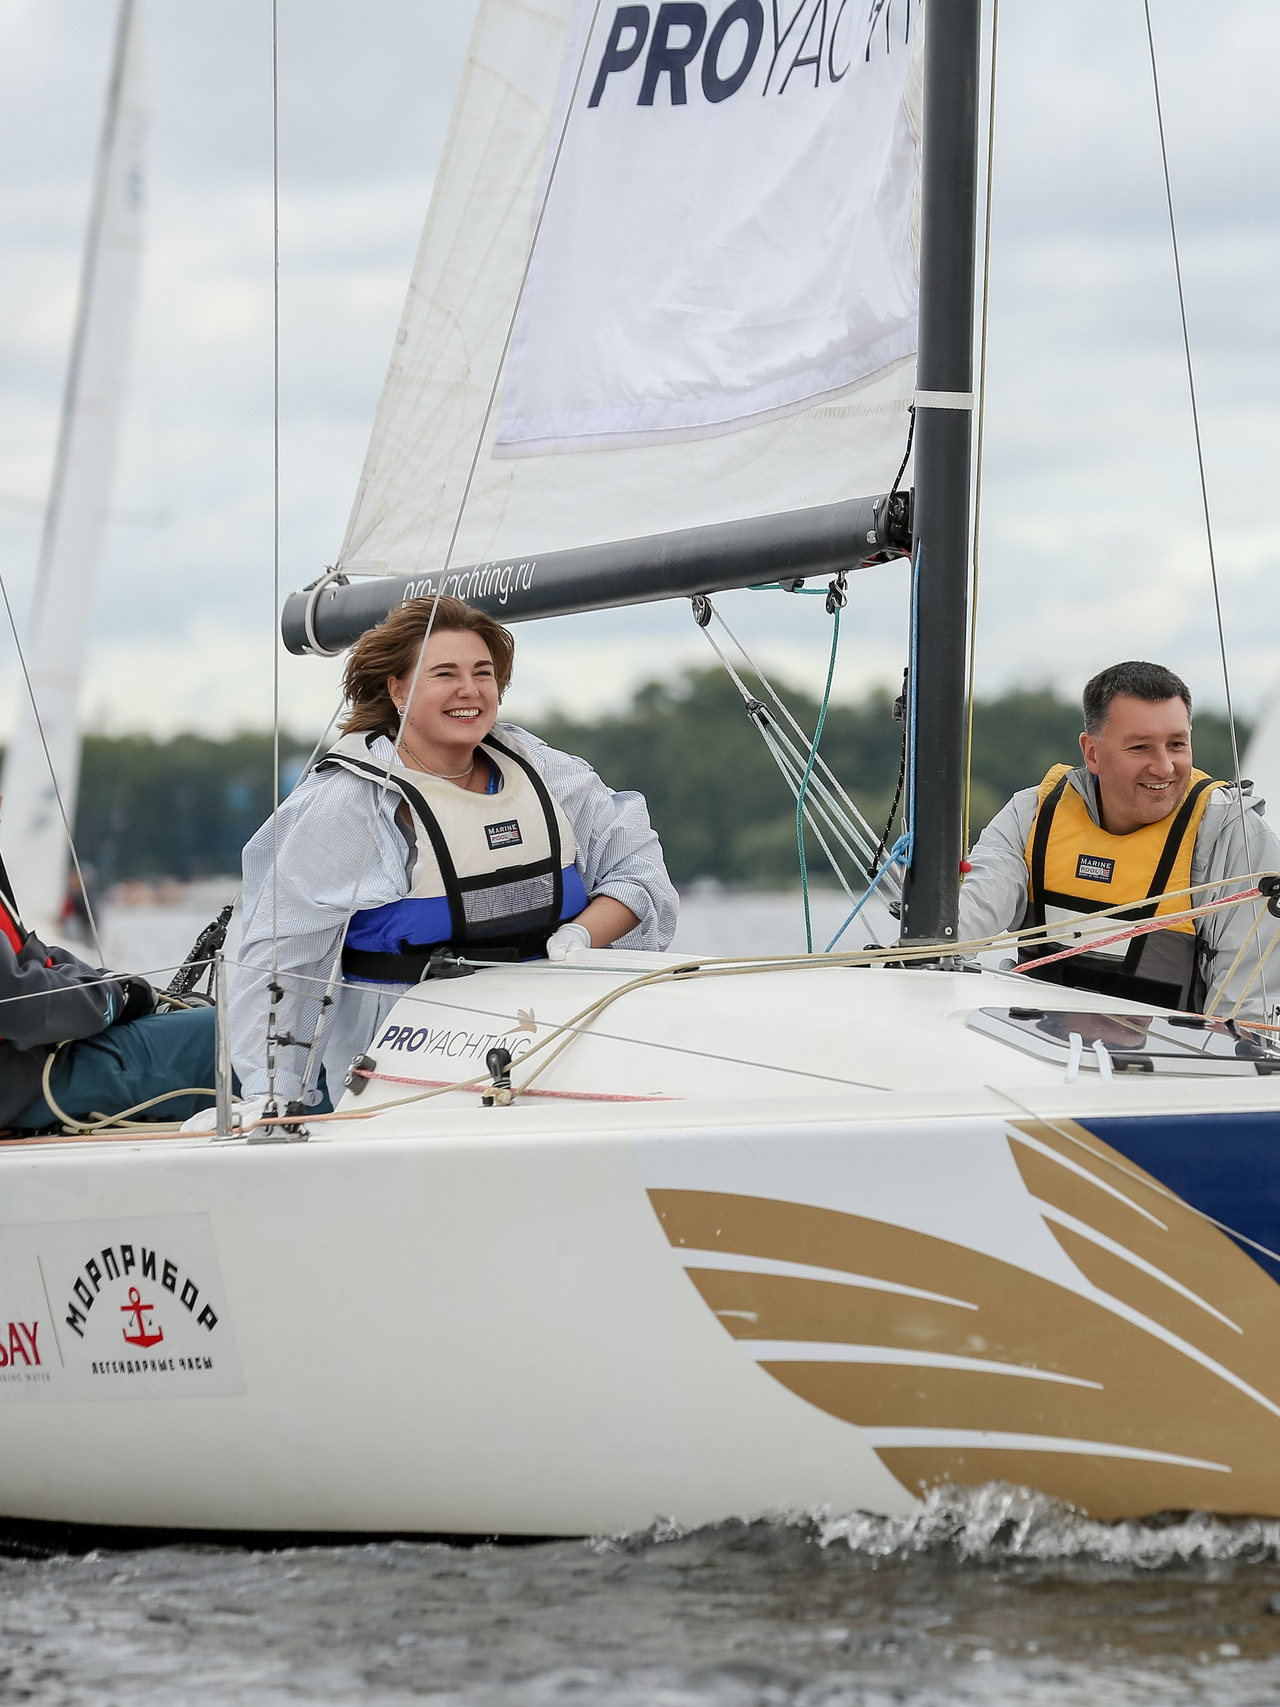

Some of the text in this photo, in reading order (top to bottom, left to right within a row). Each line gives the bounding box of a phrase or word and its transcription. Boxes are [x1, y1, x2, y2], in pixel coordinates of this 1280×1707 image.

[488, 824, 518, 835] MARINE
[1080, 858, 1112, 869] MARINE
[65, 1244, 218, 1339] МОРПРИБОР
[92, 1356, 212, 1375] ЛЕГЕНДАРНЫЕ ЧАСЫ
